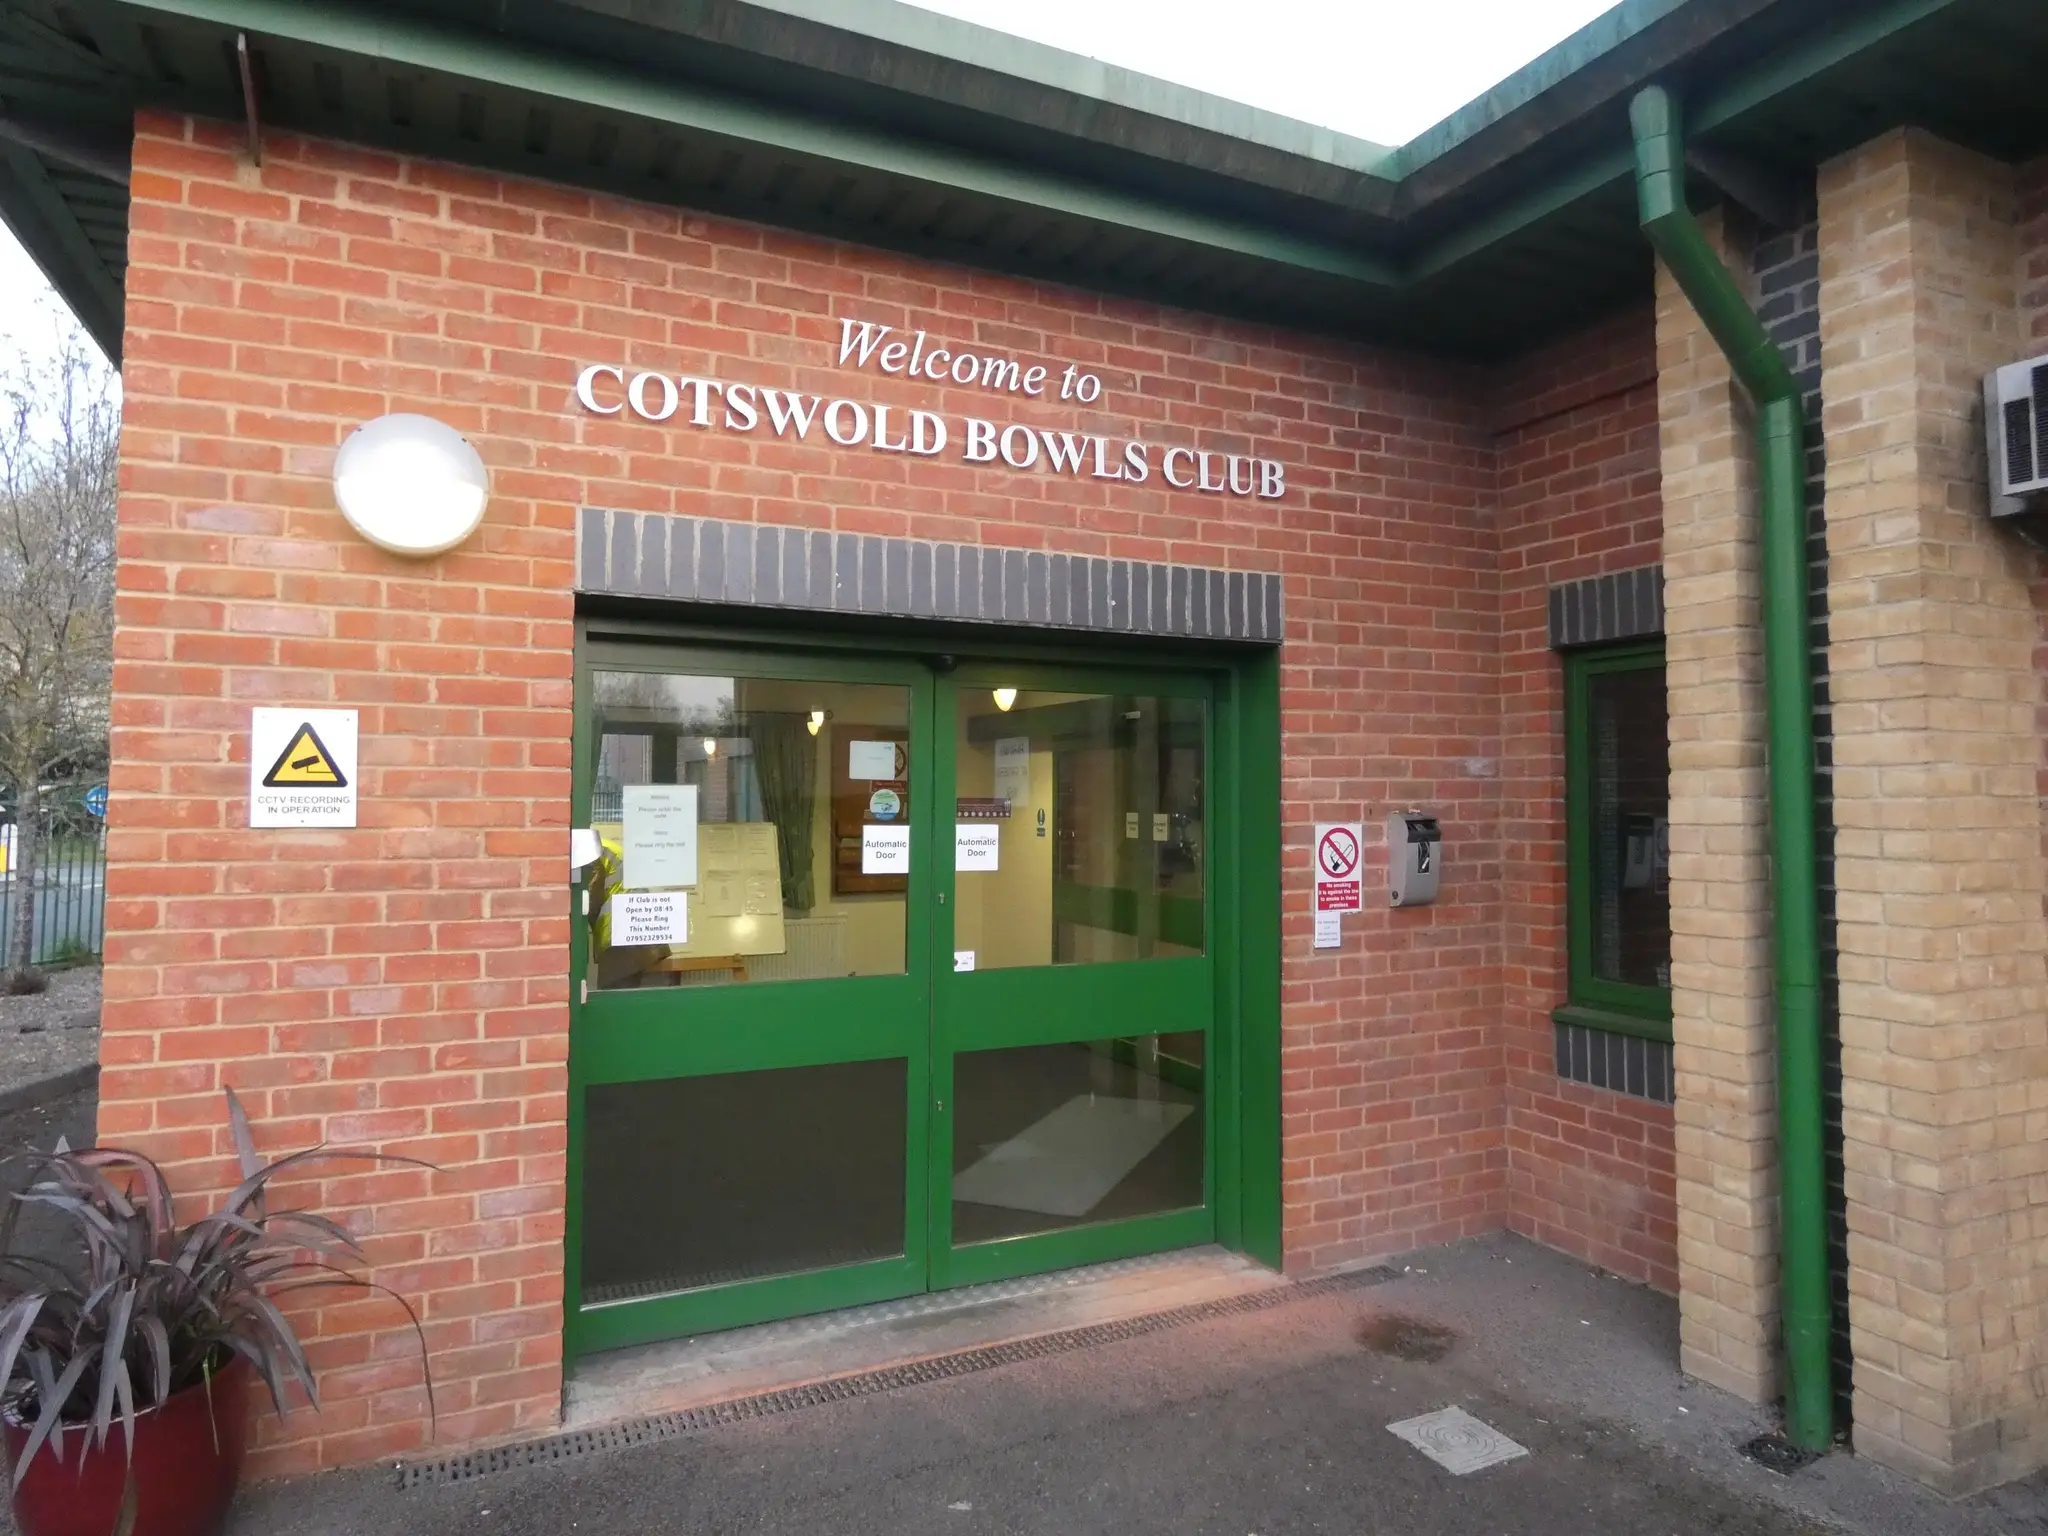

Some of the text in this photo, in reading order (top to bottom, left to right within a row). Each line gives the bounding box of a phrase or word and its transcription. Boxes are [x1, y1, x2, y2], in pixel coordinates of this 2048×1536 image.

[837, 317, 1102, 403] Welcome to
[575, 364, 1287, 498] COTSWOLD BOWLS CLUB
[258, 796, 350, 804] CCTV RECORDING
[268, 806, 341, 814] IN OPERATION
[865, 840, 907, 848] Automatic
[957, 838, 997, 846] Automatic
[876, 851, 897, 859] Door
[967, 849, 987, 857] Door
